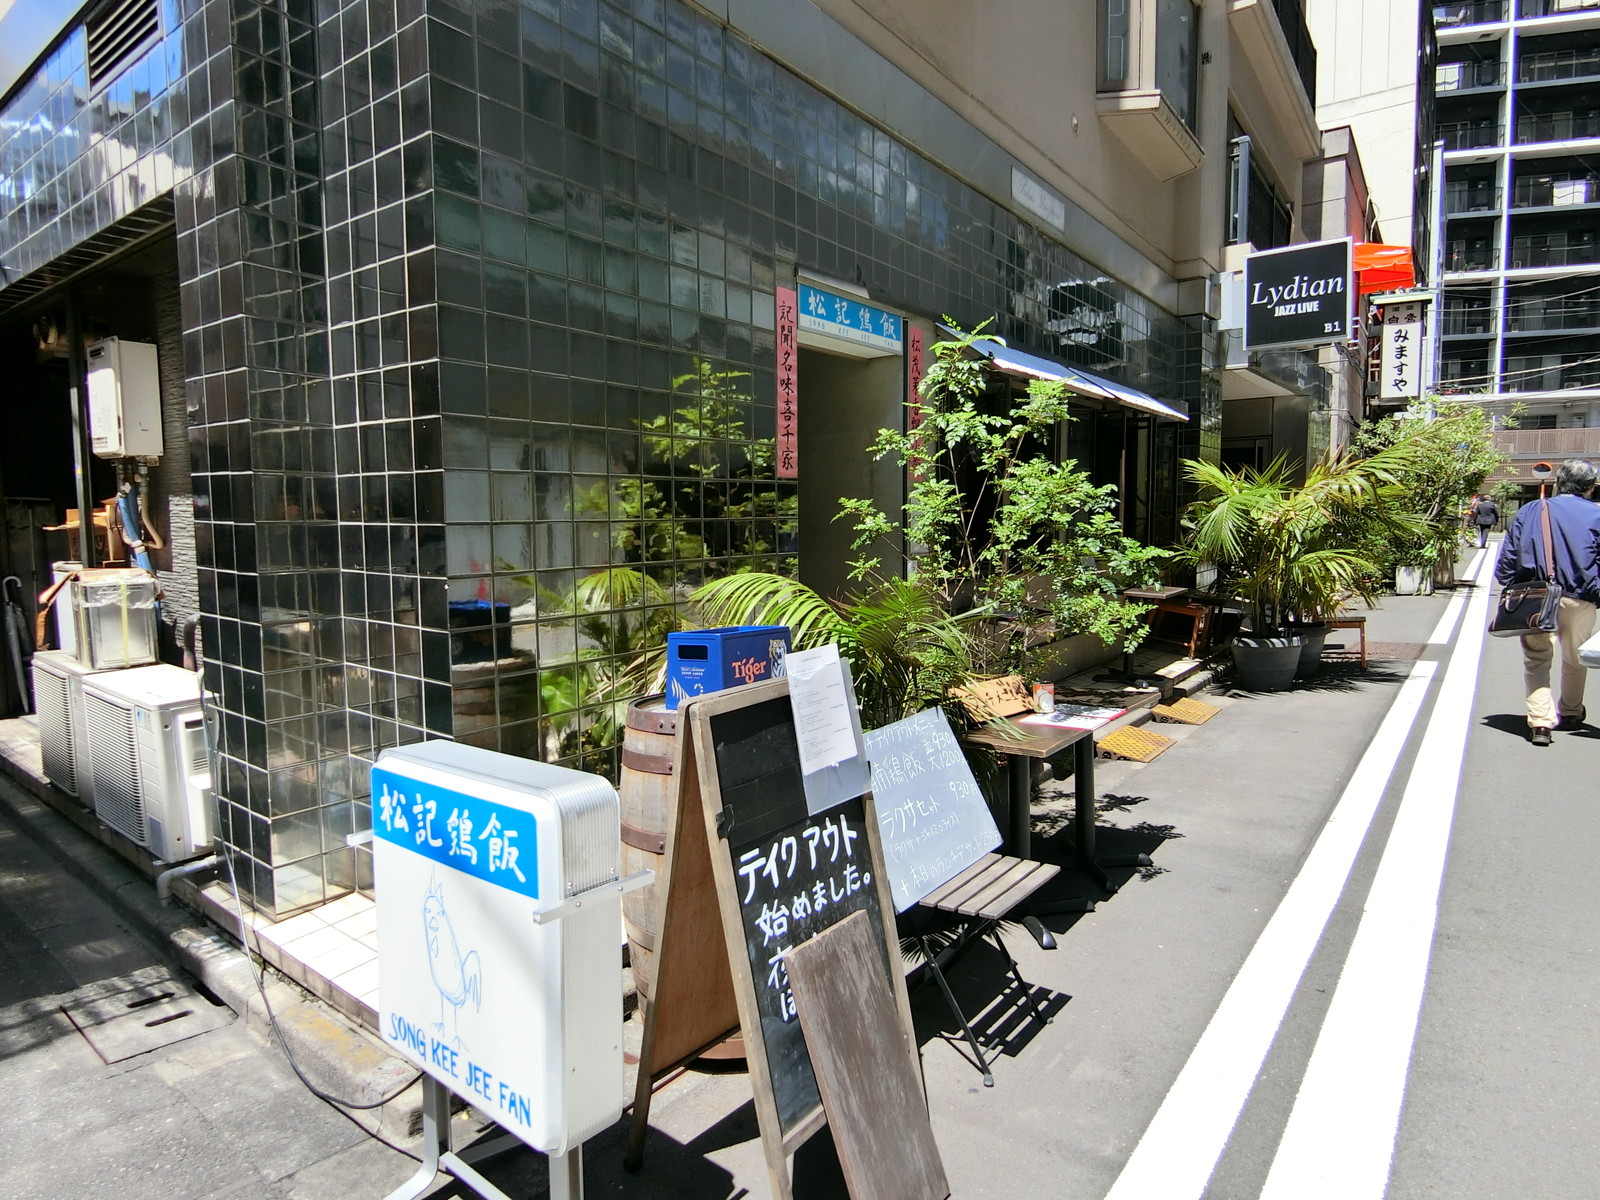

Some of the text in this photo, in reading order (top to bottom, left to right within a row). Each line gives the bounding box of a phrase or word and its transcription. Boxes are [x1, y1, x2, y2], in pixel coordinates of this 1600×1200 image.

[808, 290, 897, 340] 松記鶏飯
[1251, 275, 1343, 310] Lydian
[1274, 300, 1320, 318] JAZZ LIVE
[808, 319, 825, 330] SONG
[838, 327, 849, 337] KEE
[860, 334, 871, 343] JEE
[1323, 320, 1341, 334] B1
[1392, 328, 1409, 392] みますや
[731, 656, 767, 684] Tiger
[379, 783, 526, 884] 松記鶏飯
[880, 794, 941, 839] ラクサセット
[754, 863, 871, 948] 始めました。
[388, 1012, 532, 1128] SONG KEE JEE FAN
